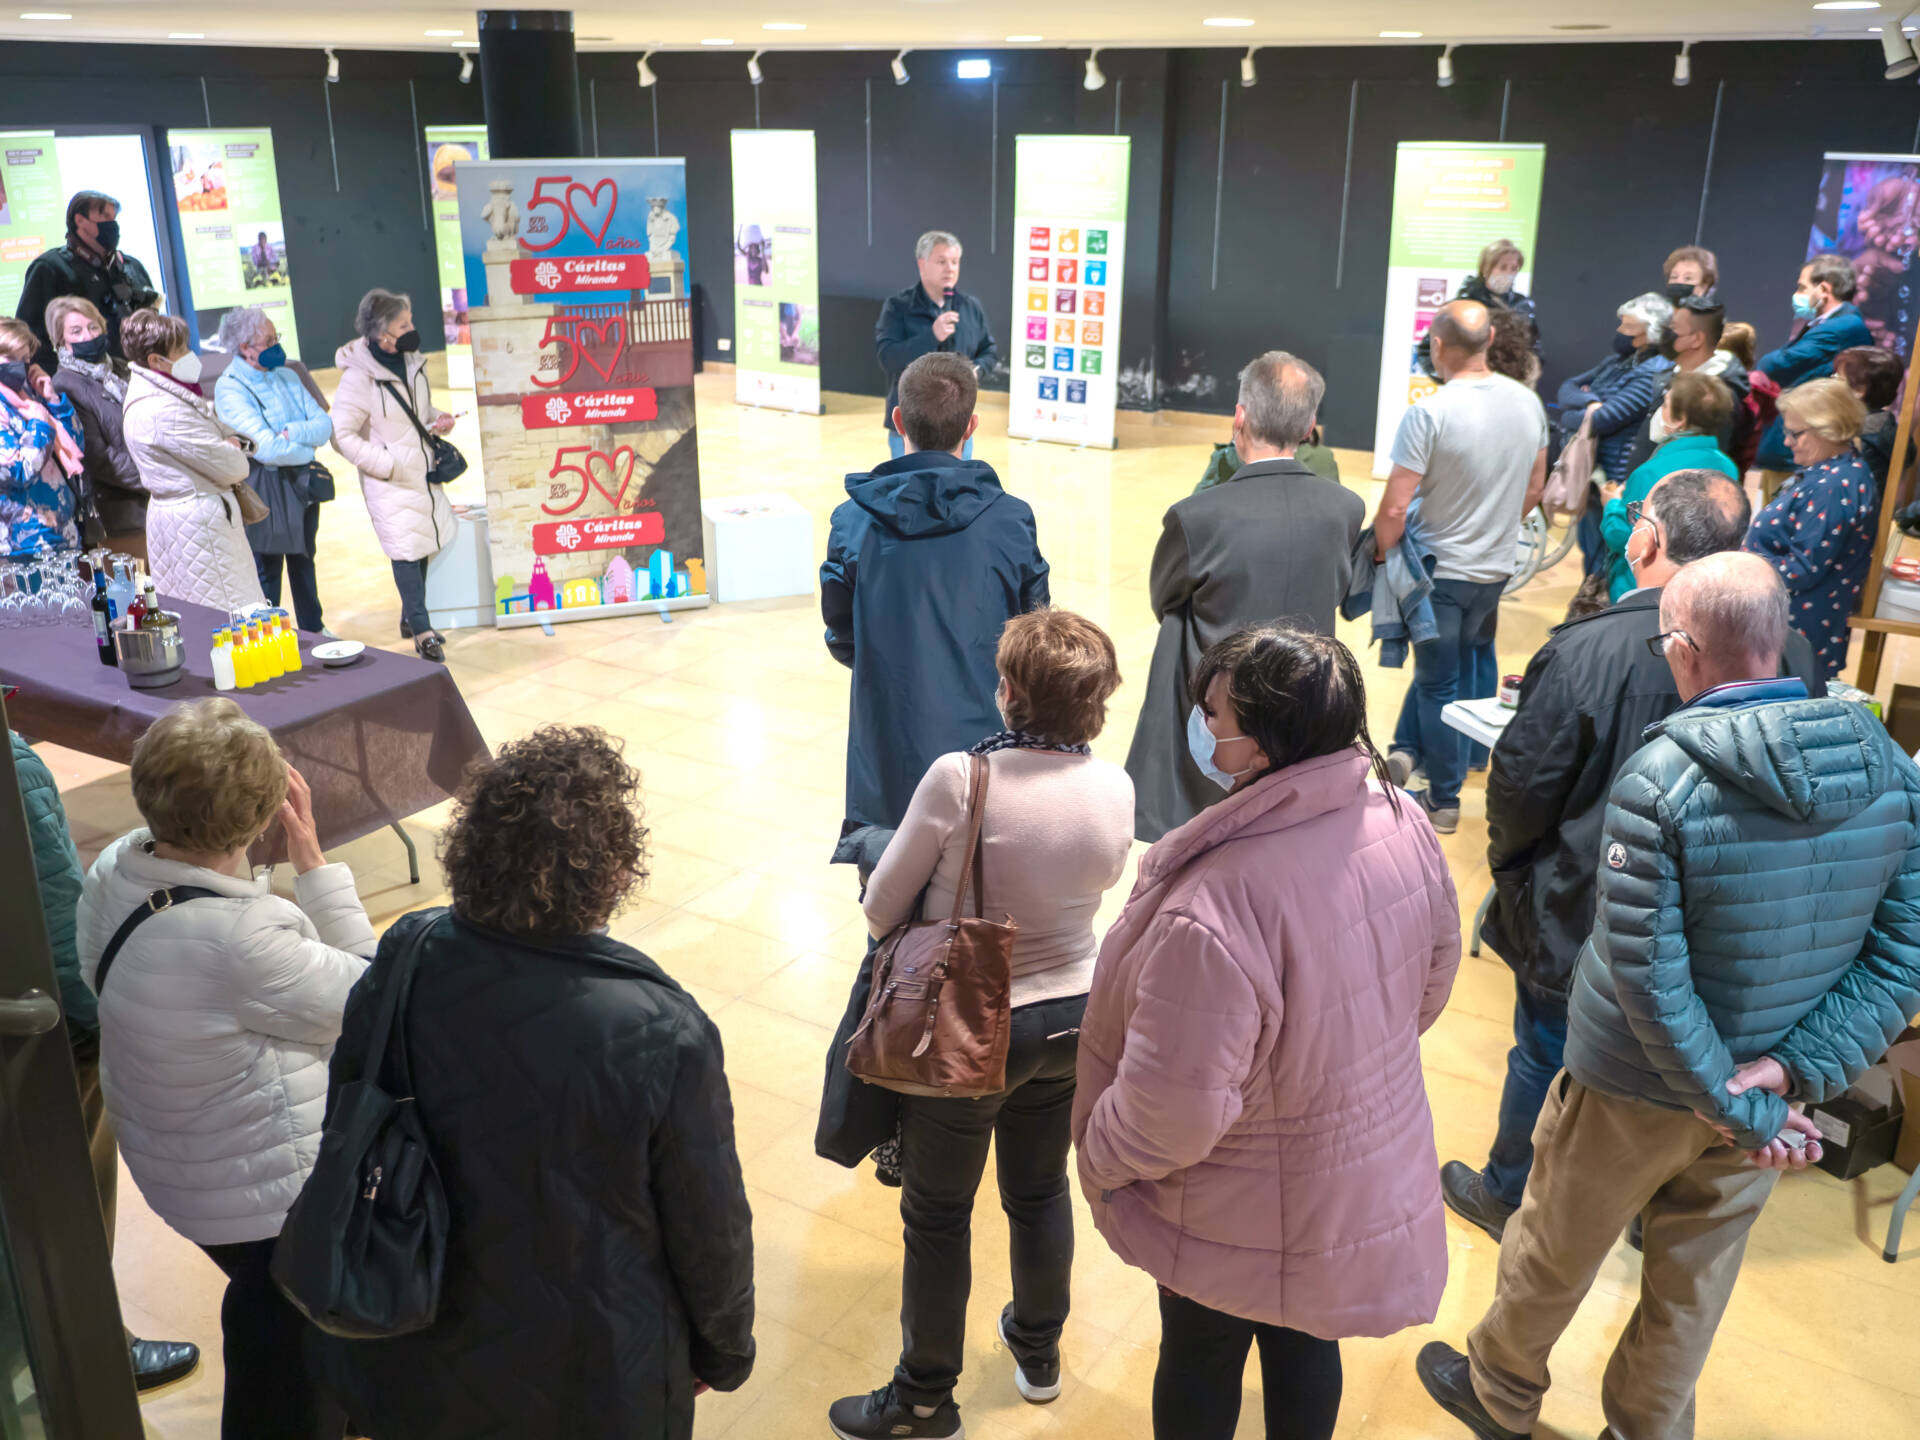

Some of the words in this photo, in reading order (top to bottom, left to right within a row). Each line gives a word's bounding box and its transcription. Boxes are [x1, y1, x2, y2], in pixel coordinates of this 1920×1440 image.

[605, 238, 641, 250] años
[564, 260, 626, 274] Cáritas
[575, 274, 618, 286] Miranda
[574, 394, 634, 408] Cáritas
[585, 407, 627, 419] Miranda
[584, 520, 642, 533] Cáritas
[594, 533, 635, 544] Miranda
